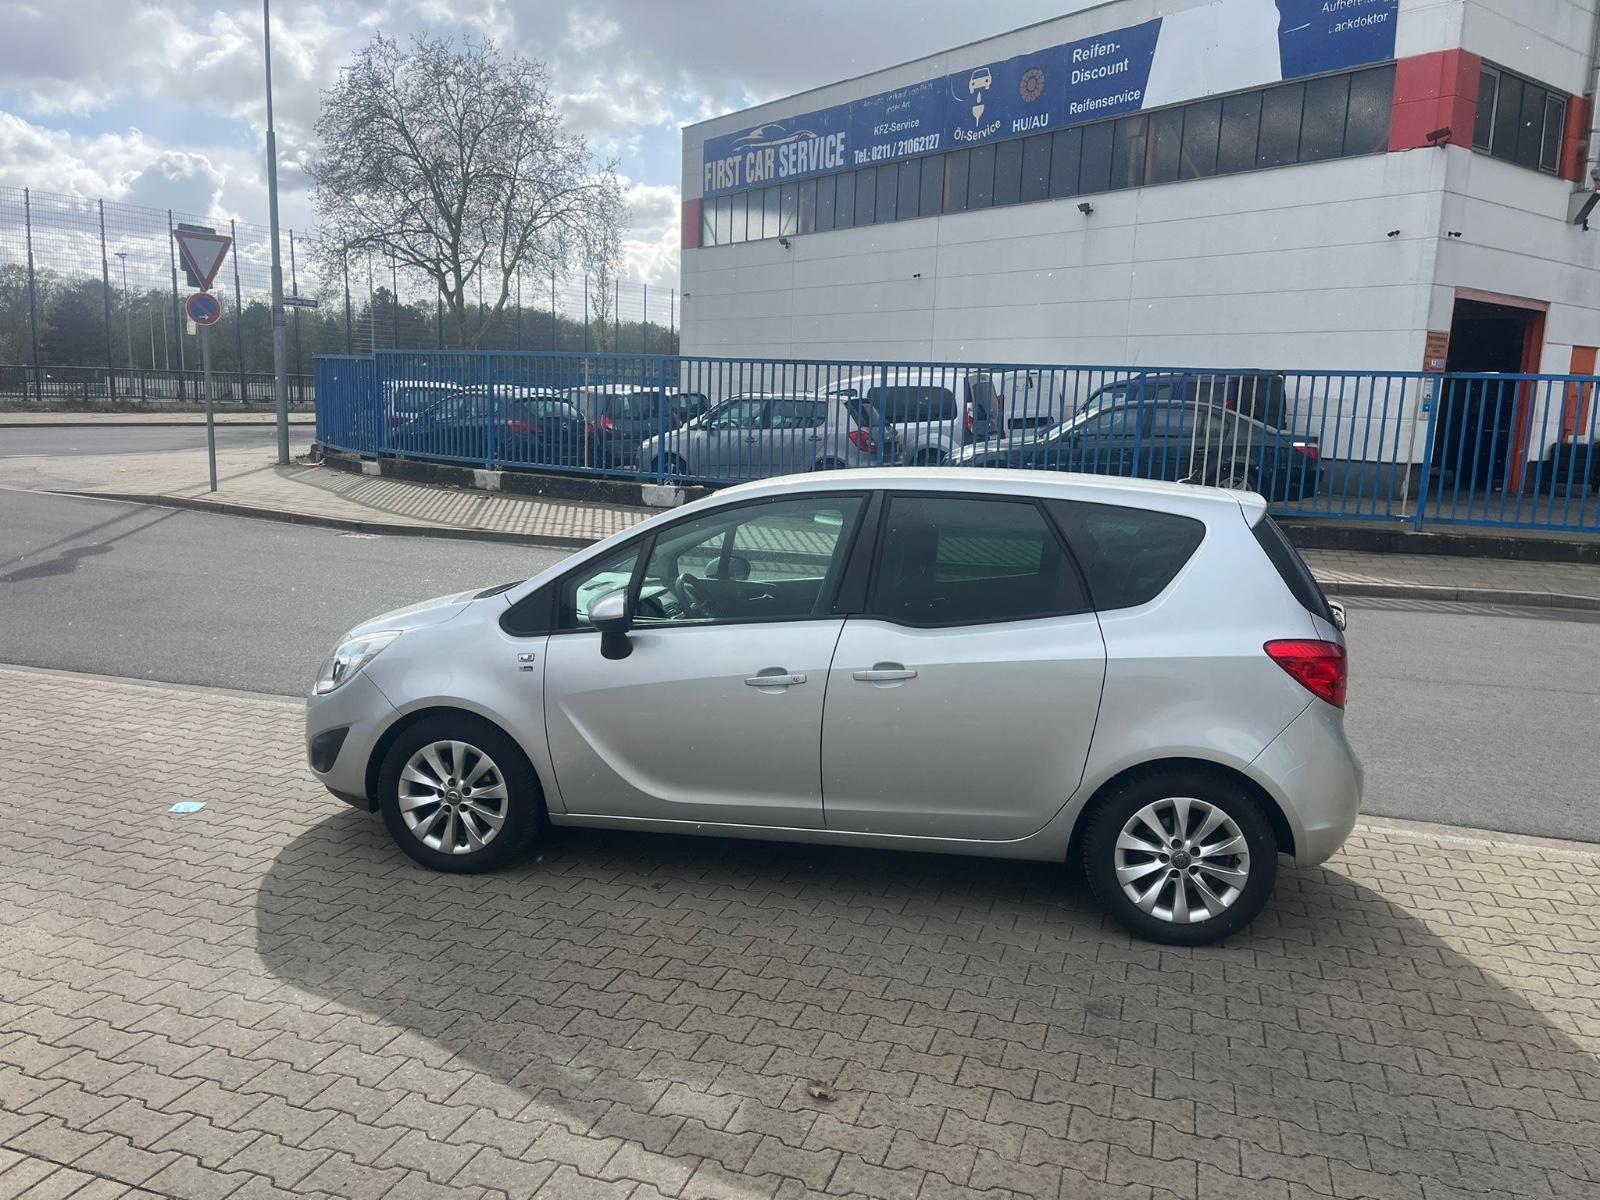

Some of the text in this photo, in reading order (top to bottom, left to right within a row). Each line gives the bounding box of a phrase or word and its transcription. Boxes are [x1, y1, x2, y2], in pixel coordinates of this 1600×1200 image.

[1072, 42, 1121, 63] Reifen-
[1071, 57, 1129, 85] Discount
[1069, 89, 1141, 115] Reifenservice
[873, 119, 920, 136] KFZ-Service
[953, 119, 1001, 141] Öl-Service
[1012, 112, 1049, 133] HU/AU
[871, 143, 891, 161] 0211
[891, 142, 897, 157] /
[897, 133, 940, 156] 21062127
[704, 131, 846, 192] FIRST CAR SERVICE
